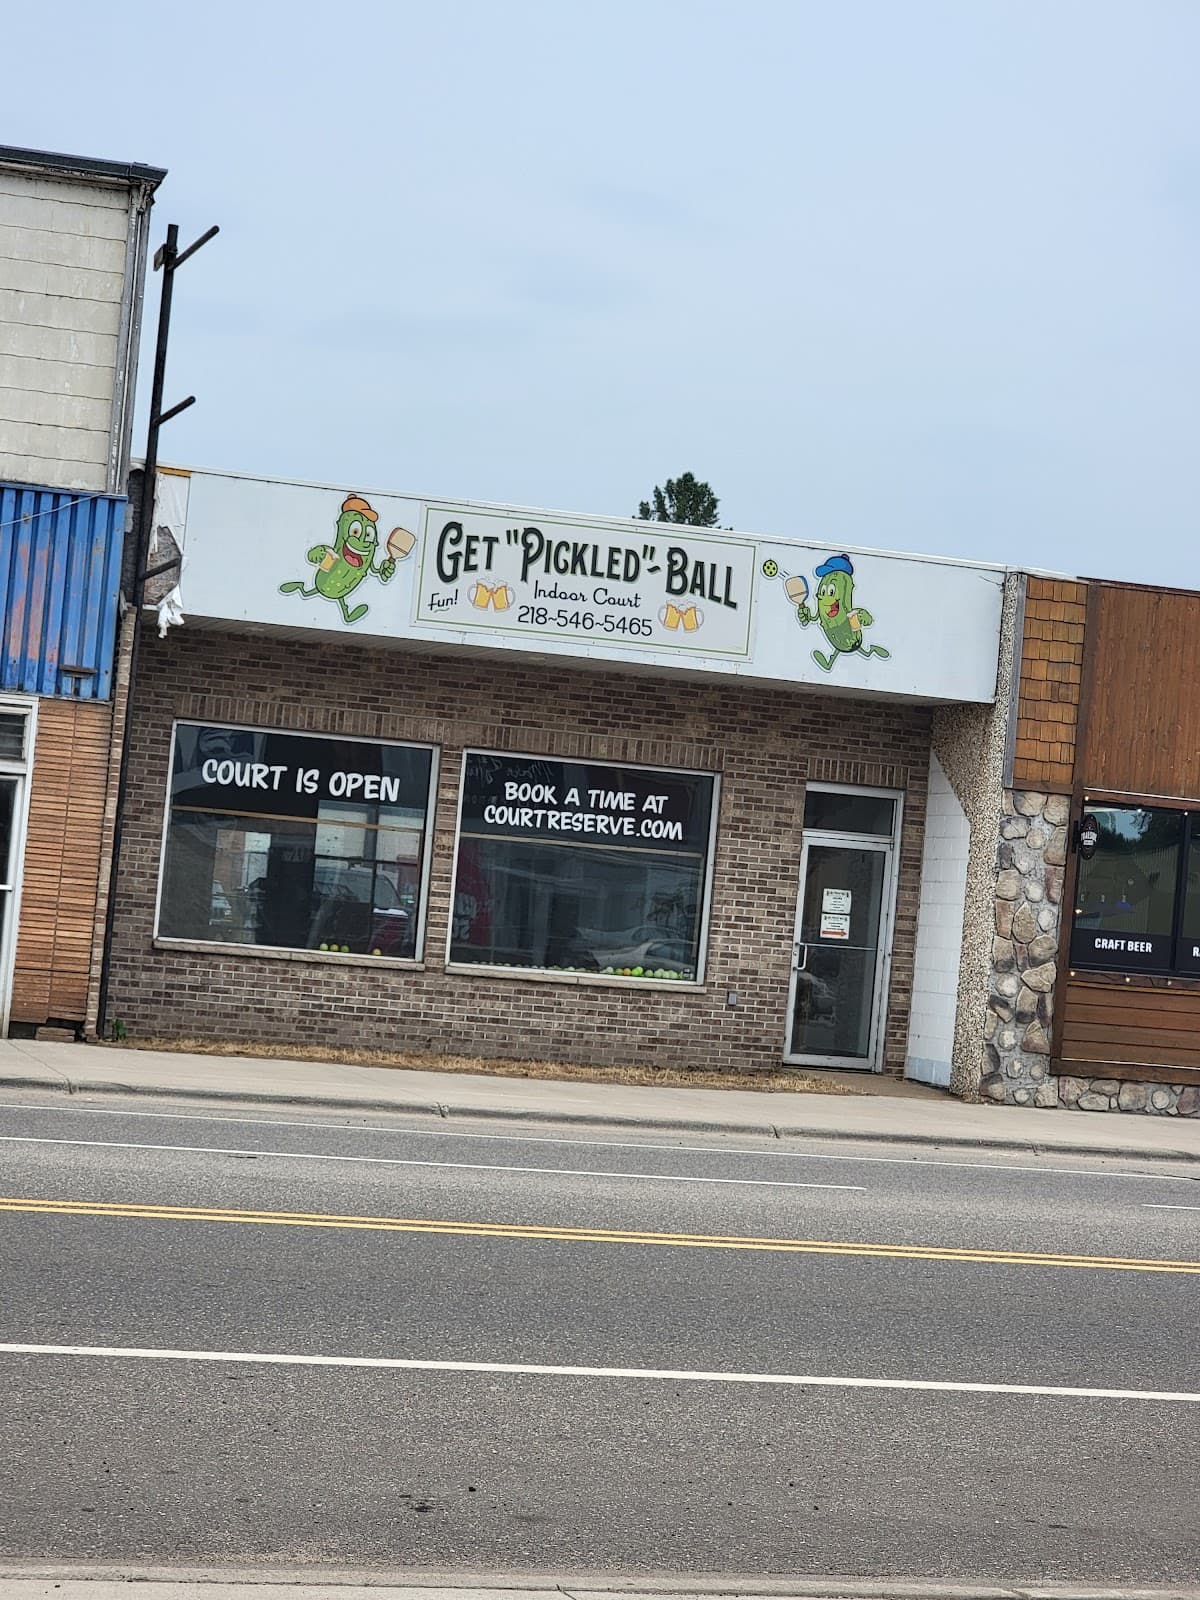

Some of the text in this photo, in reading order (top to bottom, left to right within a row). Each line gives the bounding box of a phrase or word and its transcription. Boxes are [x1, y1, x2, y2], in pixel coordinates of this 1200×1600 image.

[427, 589, 459, 611] Fun!
[533, 579, 642, 608] Indoor Court
[202, 758, 400, 802] COURT IS OPEN
[504, 781, 669, 814] BOOK A TIME AT
[484, 805, 683, 841] COURTRESERVE.COM
[1094, 937, 1153, 953] CRAFT BEER
